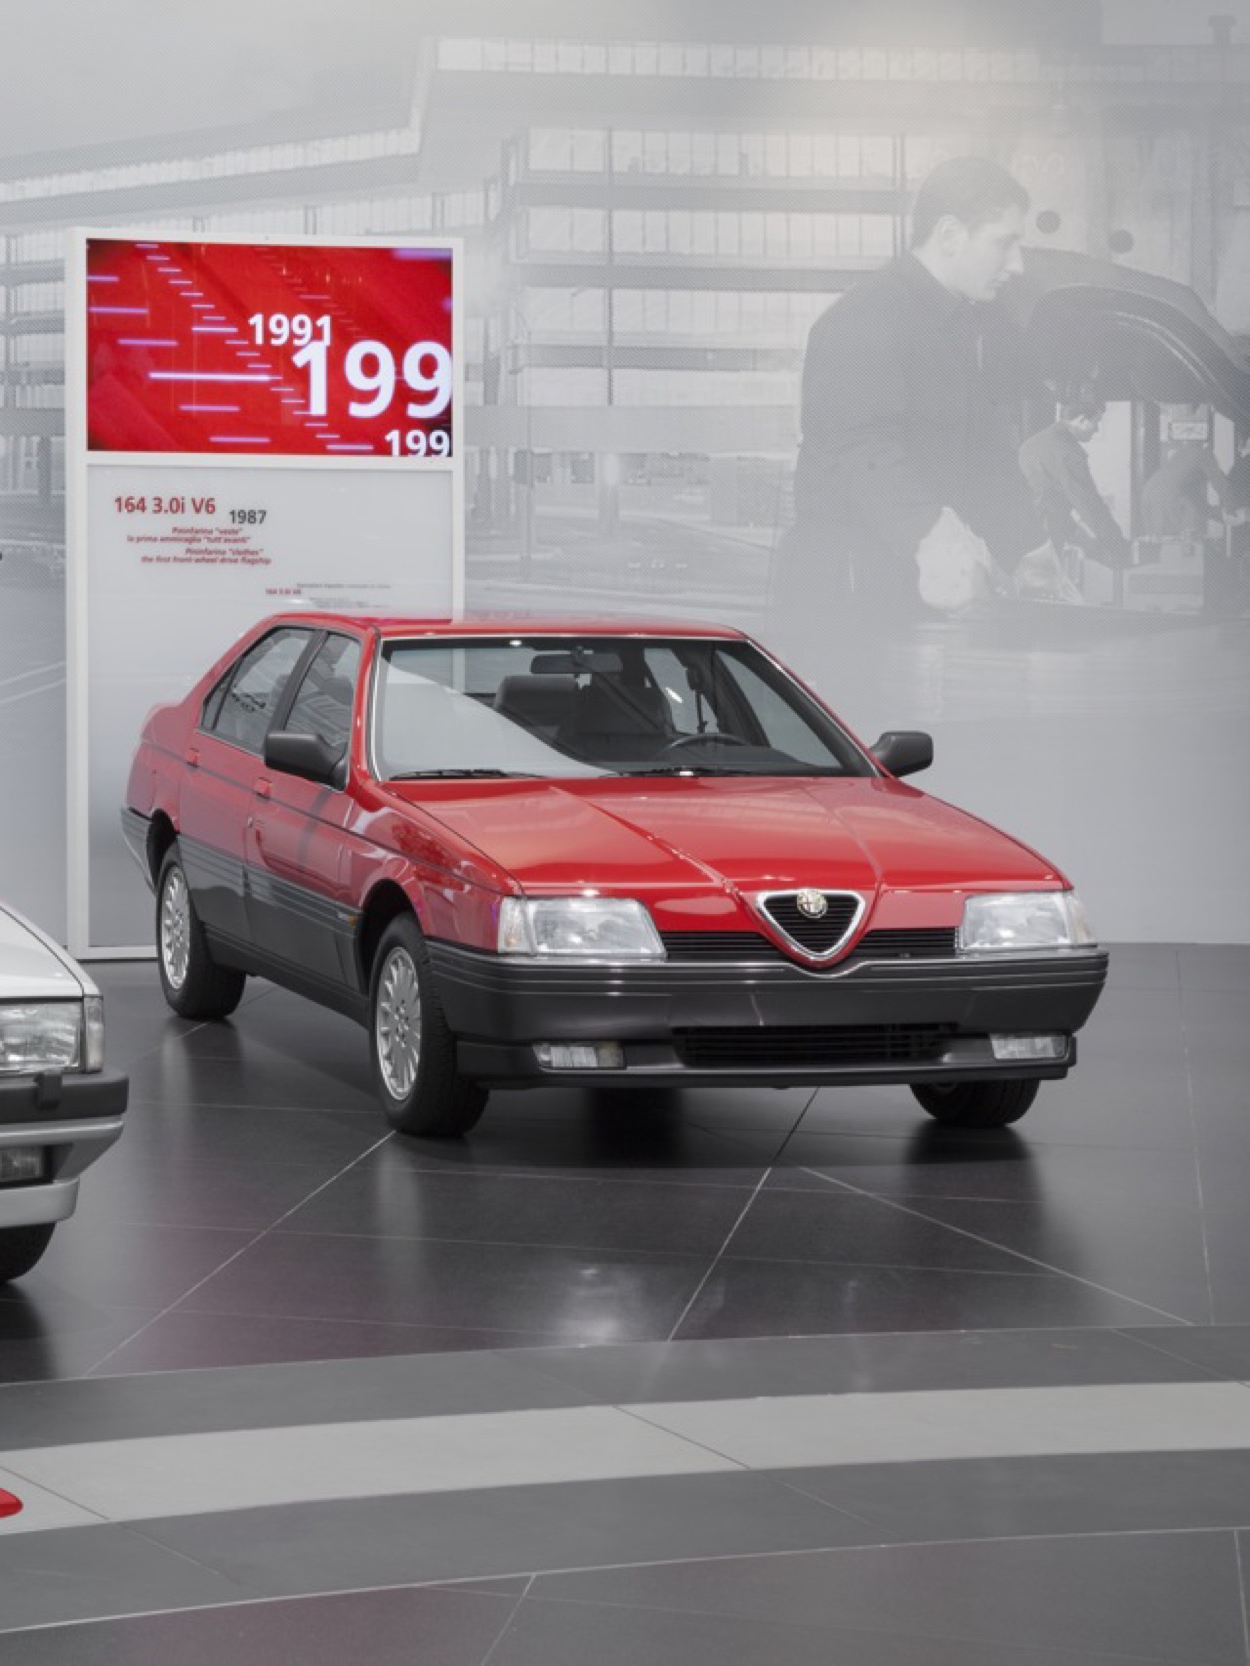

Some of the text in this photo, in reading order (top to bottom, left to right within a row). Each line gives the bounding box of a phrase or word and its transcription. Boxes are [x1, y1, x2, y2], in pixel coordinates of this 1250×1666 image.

[248, 313, 331, 347] 1991
[291, 340, 453, 419] 199
[114, 496, 216, 514] 164 3.0i V6
[229, 509, 267, 525] 1987
